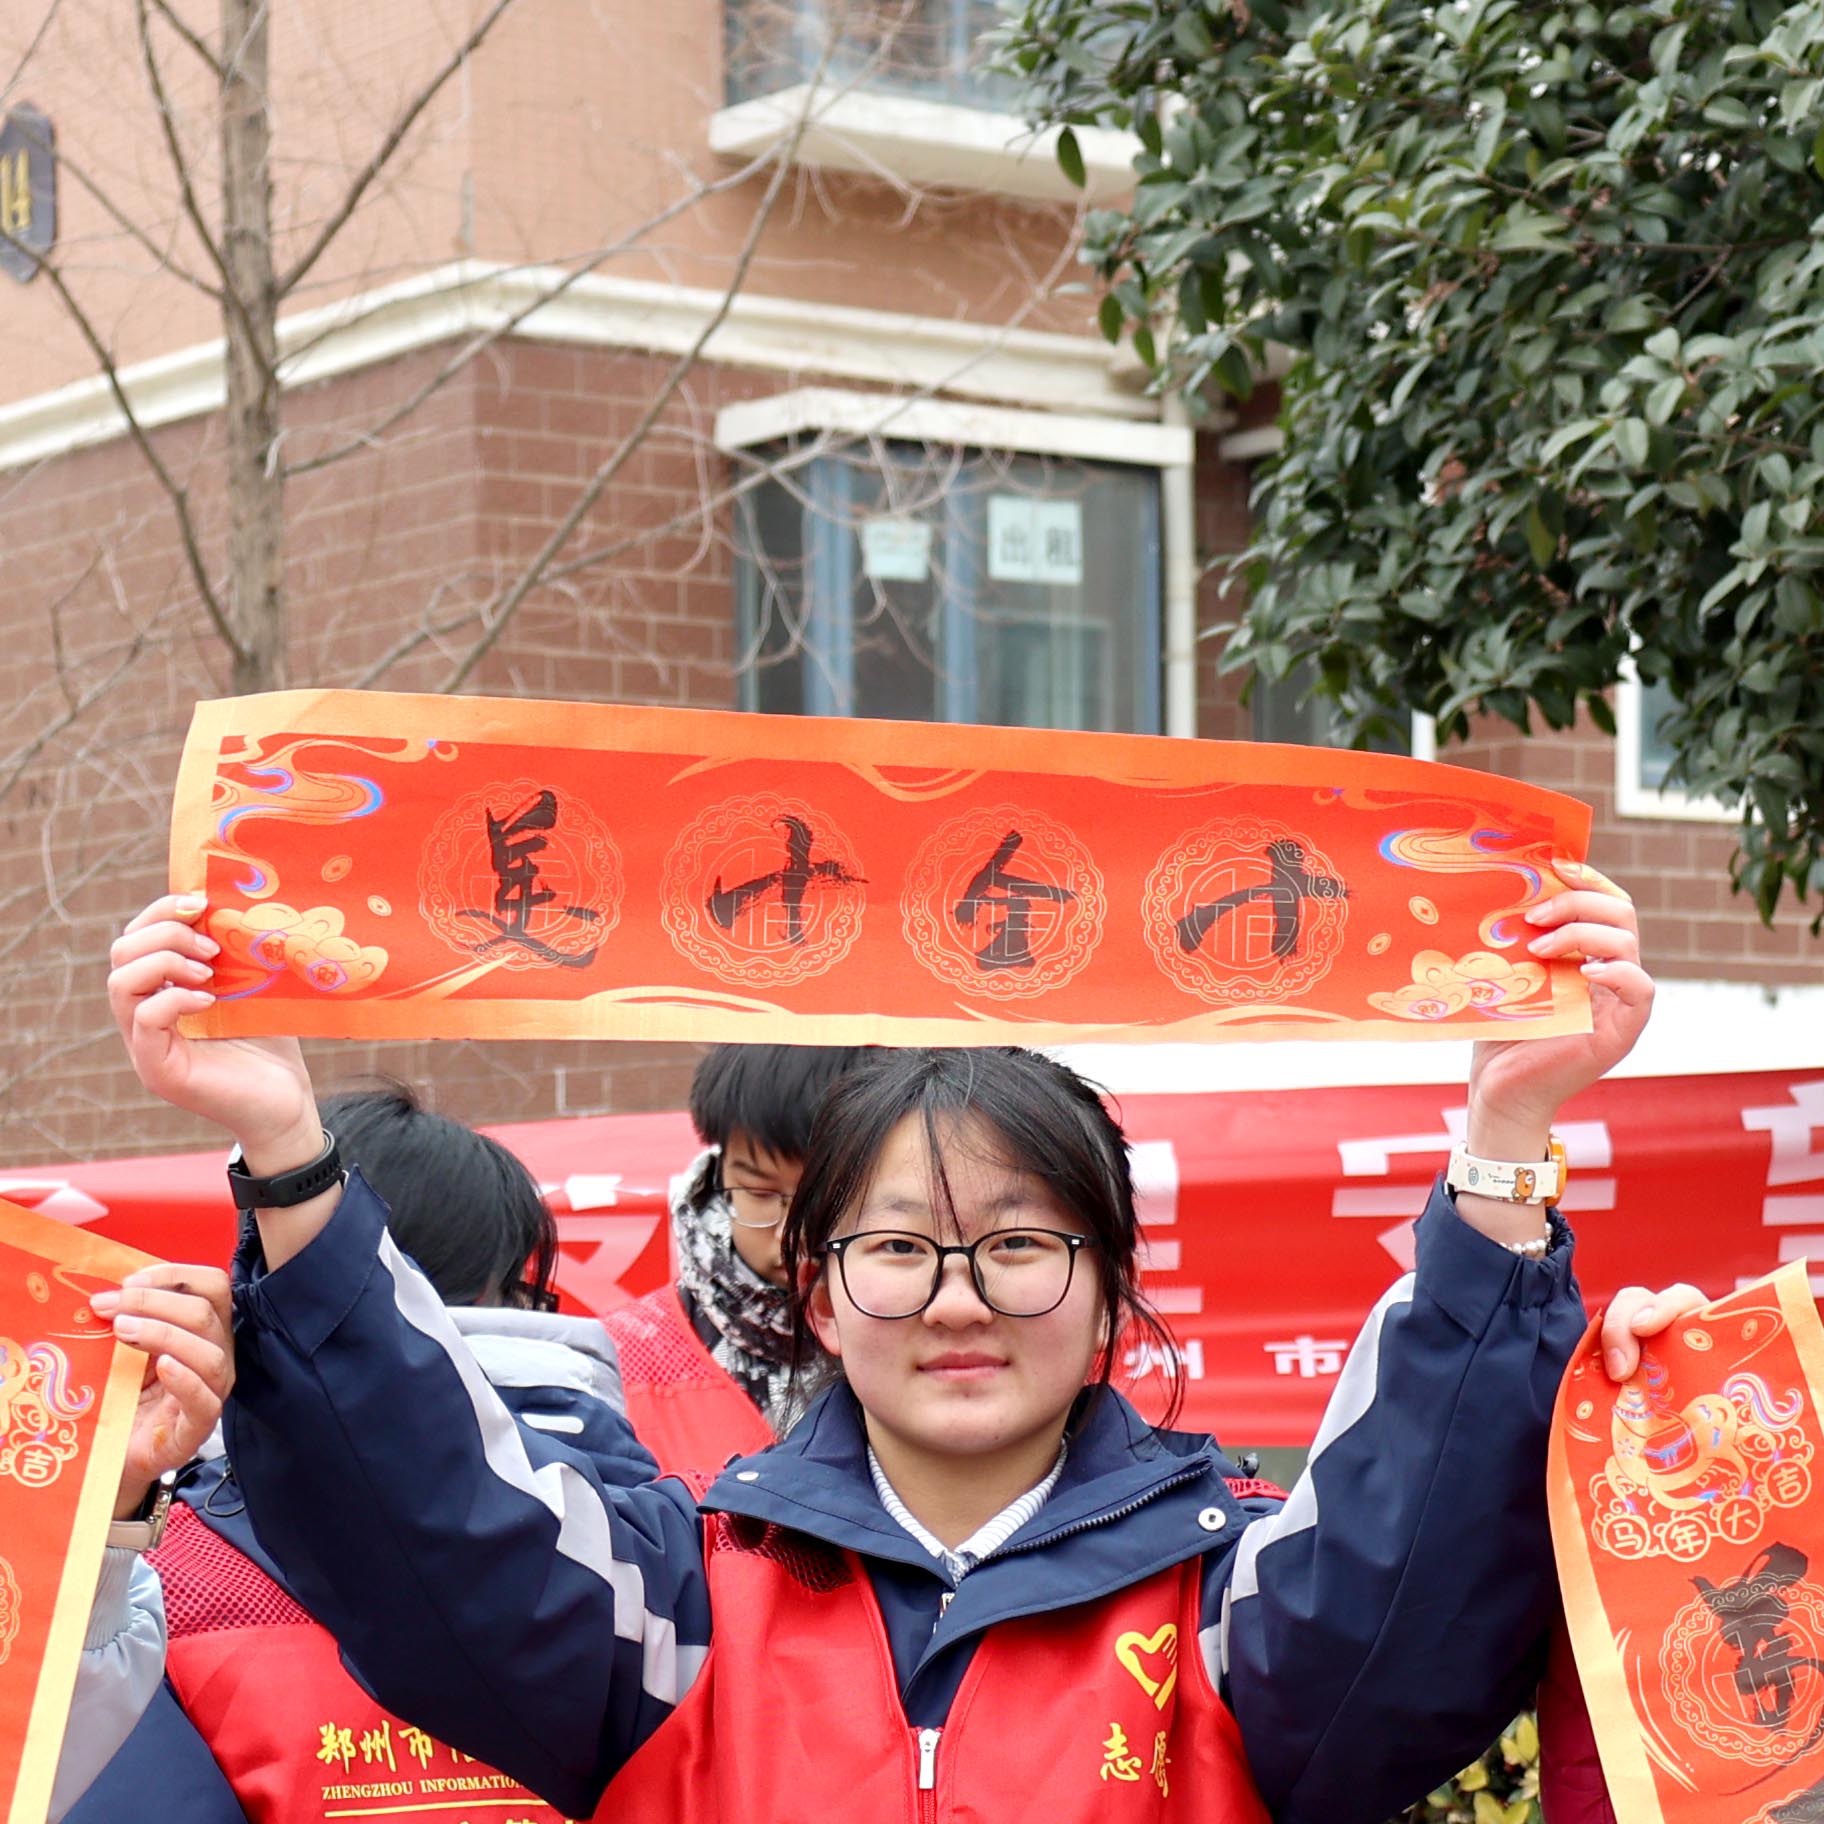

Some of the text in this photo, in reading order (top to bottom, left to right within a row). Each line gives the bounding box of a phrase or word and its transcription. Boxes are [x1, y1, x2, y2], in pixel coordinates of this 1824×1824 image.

[1608, 1465, 1808, 1556] 马年大吉
[321, 1779, 414, 1801] ZHENGZHOU
